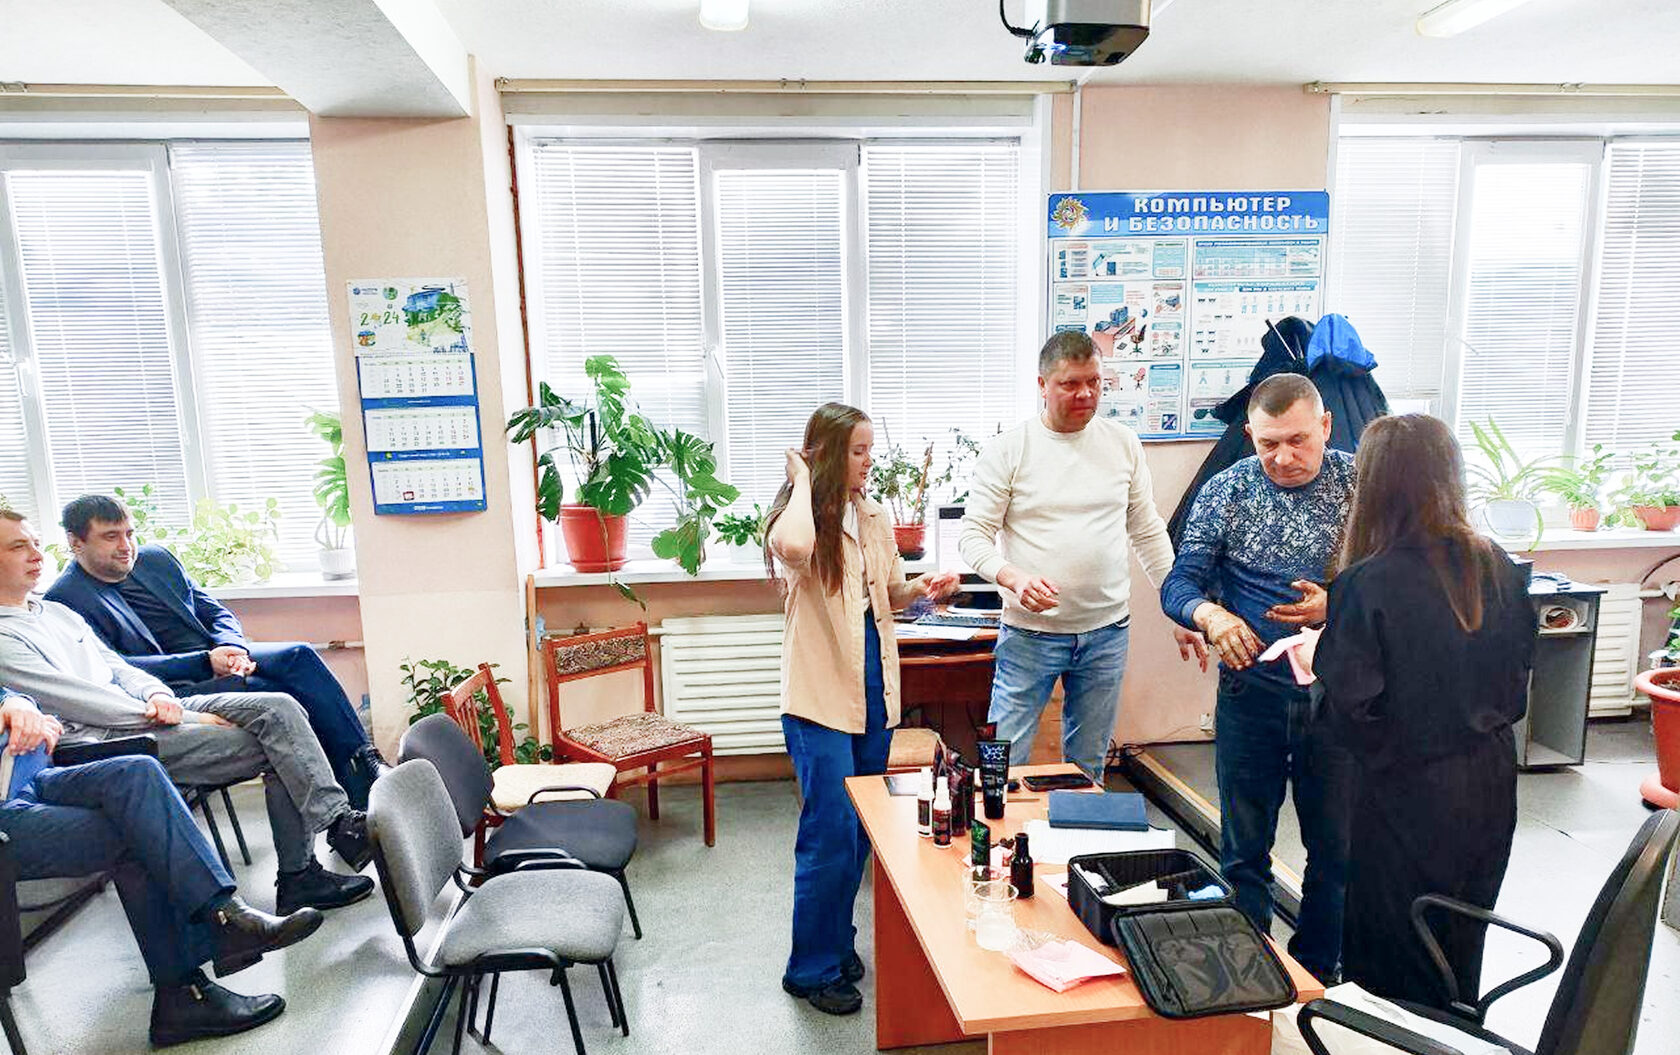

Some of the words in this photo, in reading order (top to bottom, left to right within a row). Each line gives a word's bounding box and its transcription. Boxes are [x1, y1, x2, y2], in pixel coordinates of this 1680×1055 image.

[1134, 196, 1292, 213] КОМПЬЮТЕР
[1104, 216, 1119, 232] И
[1128, 214, 1319, 232] БЕЗОПАСНОСТЬ
